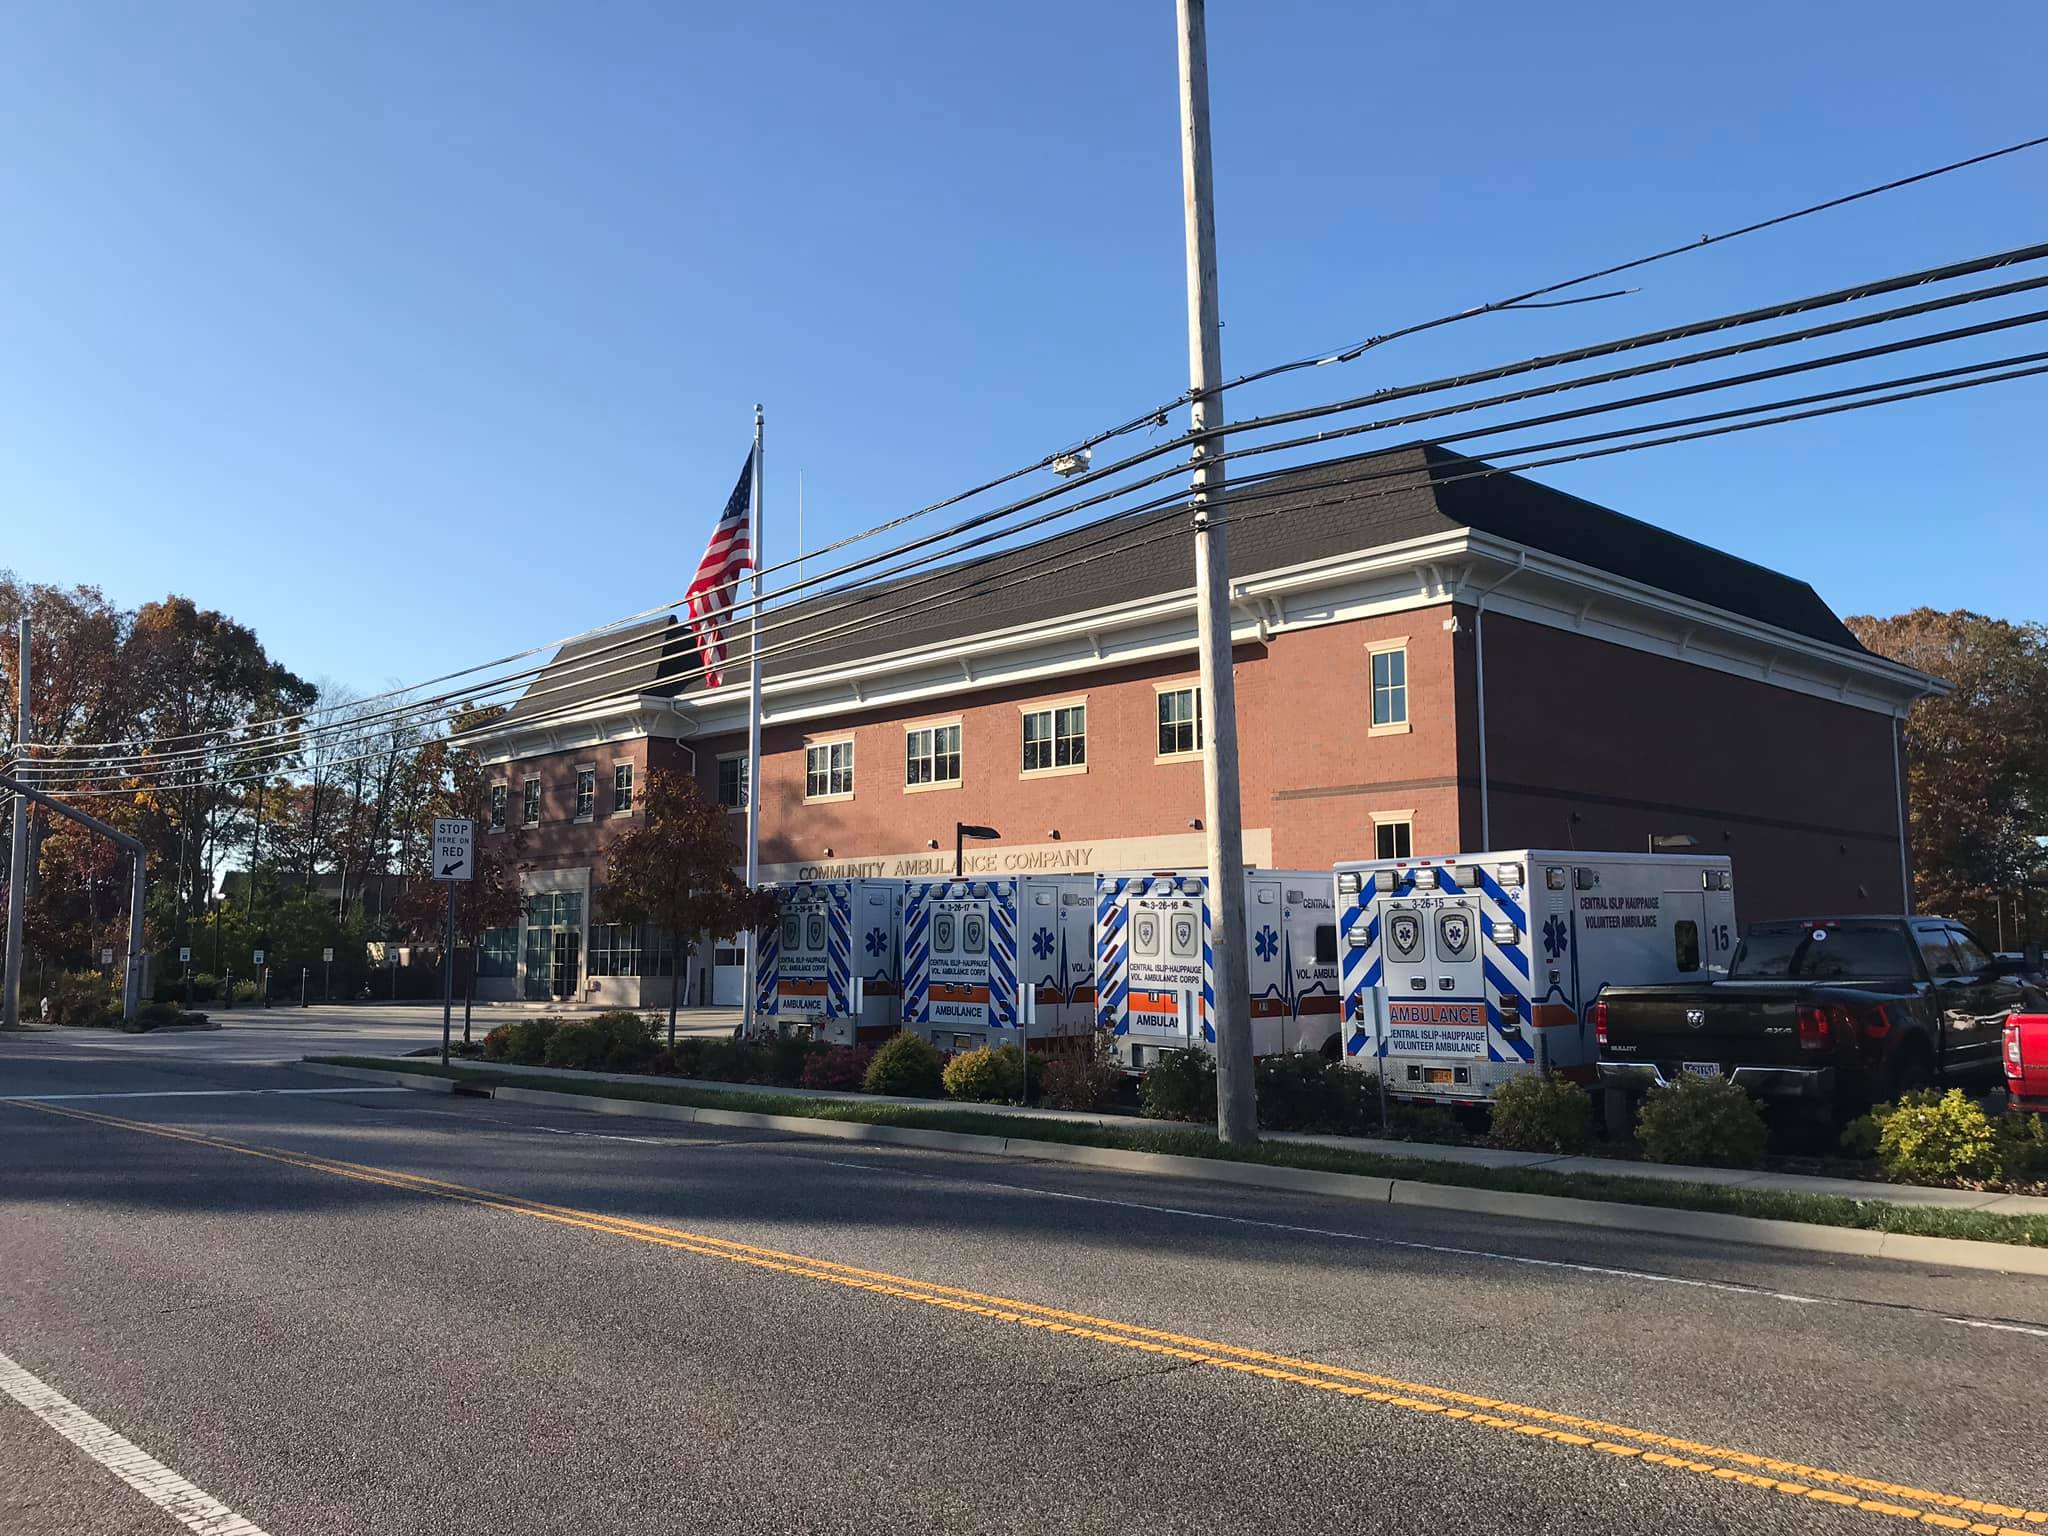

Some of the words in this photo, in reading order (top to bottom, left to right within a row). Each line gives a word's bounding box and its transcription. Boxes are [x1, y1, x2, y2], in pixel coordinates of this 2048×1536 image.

[439, 823, 468, 834] STOP
[442, 846, 464, 857] RED
[800, 861, 885, 881] COMMUNITY
[895, 853, 998, 876] AMBULANCE
[1004, 847, 1093, 871] COMPANY
[947, 903, 971, 912] 3-26-17
[1303, 898, 1330, 909] CENTRAL
[1411, 898, 1444, 909] 3-26-15
[1580, 896, 1608, 909] CENTRAL
[1585, 915, 1620, 928] VOLUNTEER
[1621, 915, 1657, 928] AMBULANCE
[1711, 924, 1729, 951] 15
[970, 968, 986, 976] CORPS
[1130, 963, 1153, 972] CENTRAL
[1155, 964, 1202, 974] ISLIP-HAUPPAUGE
[1296, 968, 1311, 979] VOL.
[1131, 973, 1142, 981] VOL.
[1144, 974, 1178, 983] AMBULANCE
[1180, 976, 1200, 984] CORPS
[783, 999, 821, 1009] AMBULANCE
[935, 1005, 982, 1017] AMBULANCE
[1390, 1007, 1480, 1023] AMBULANCE
[1421, 1031, 1485, 1041] ISLIP-HAUPPAUGE
[1393, 1041, 1434, 1051] VOLUNTEER
[1435, 1042, 1481, 1053] AMBULANCE
